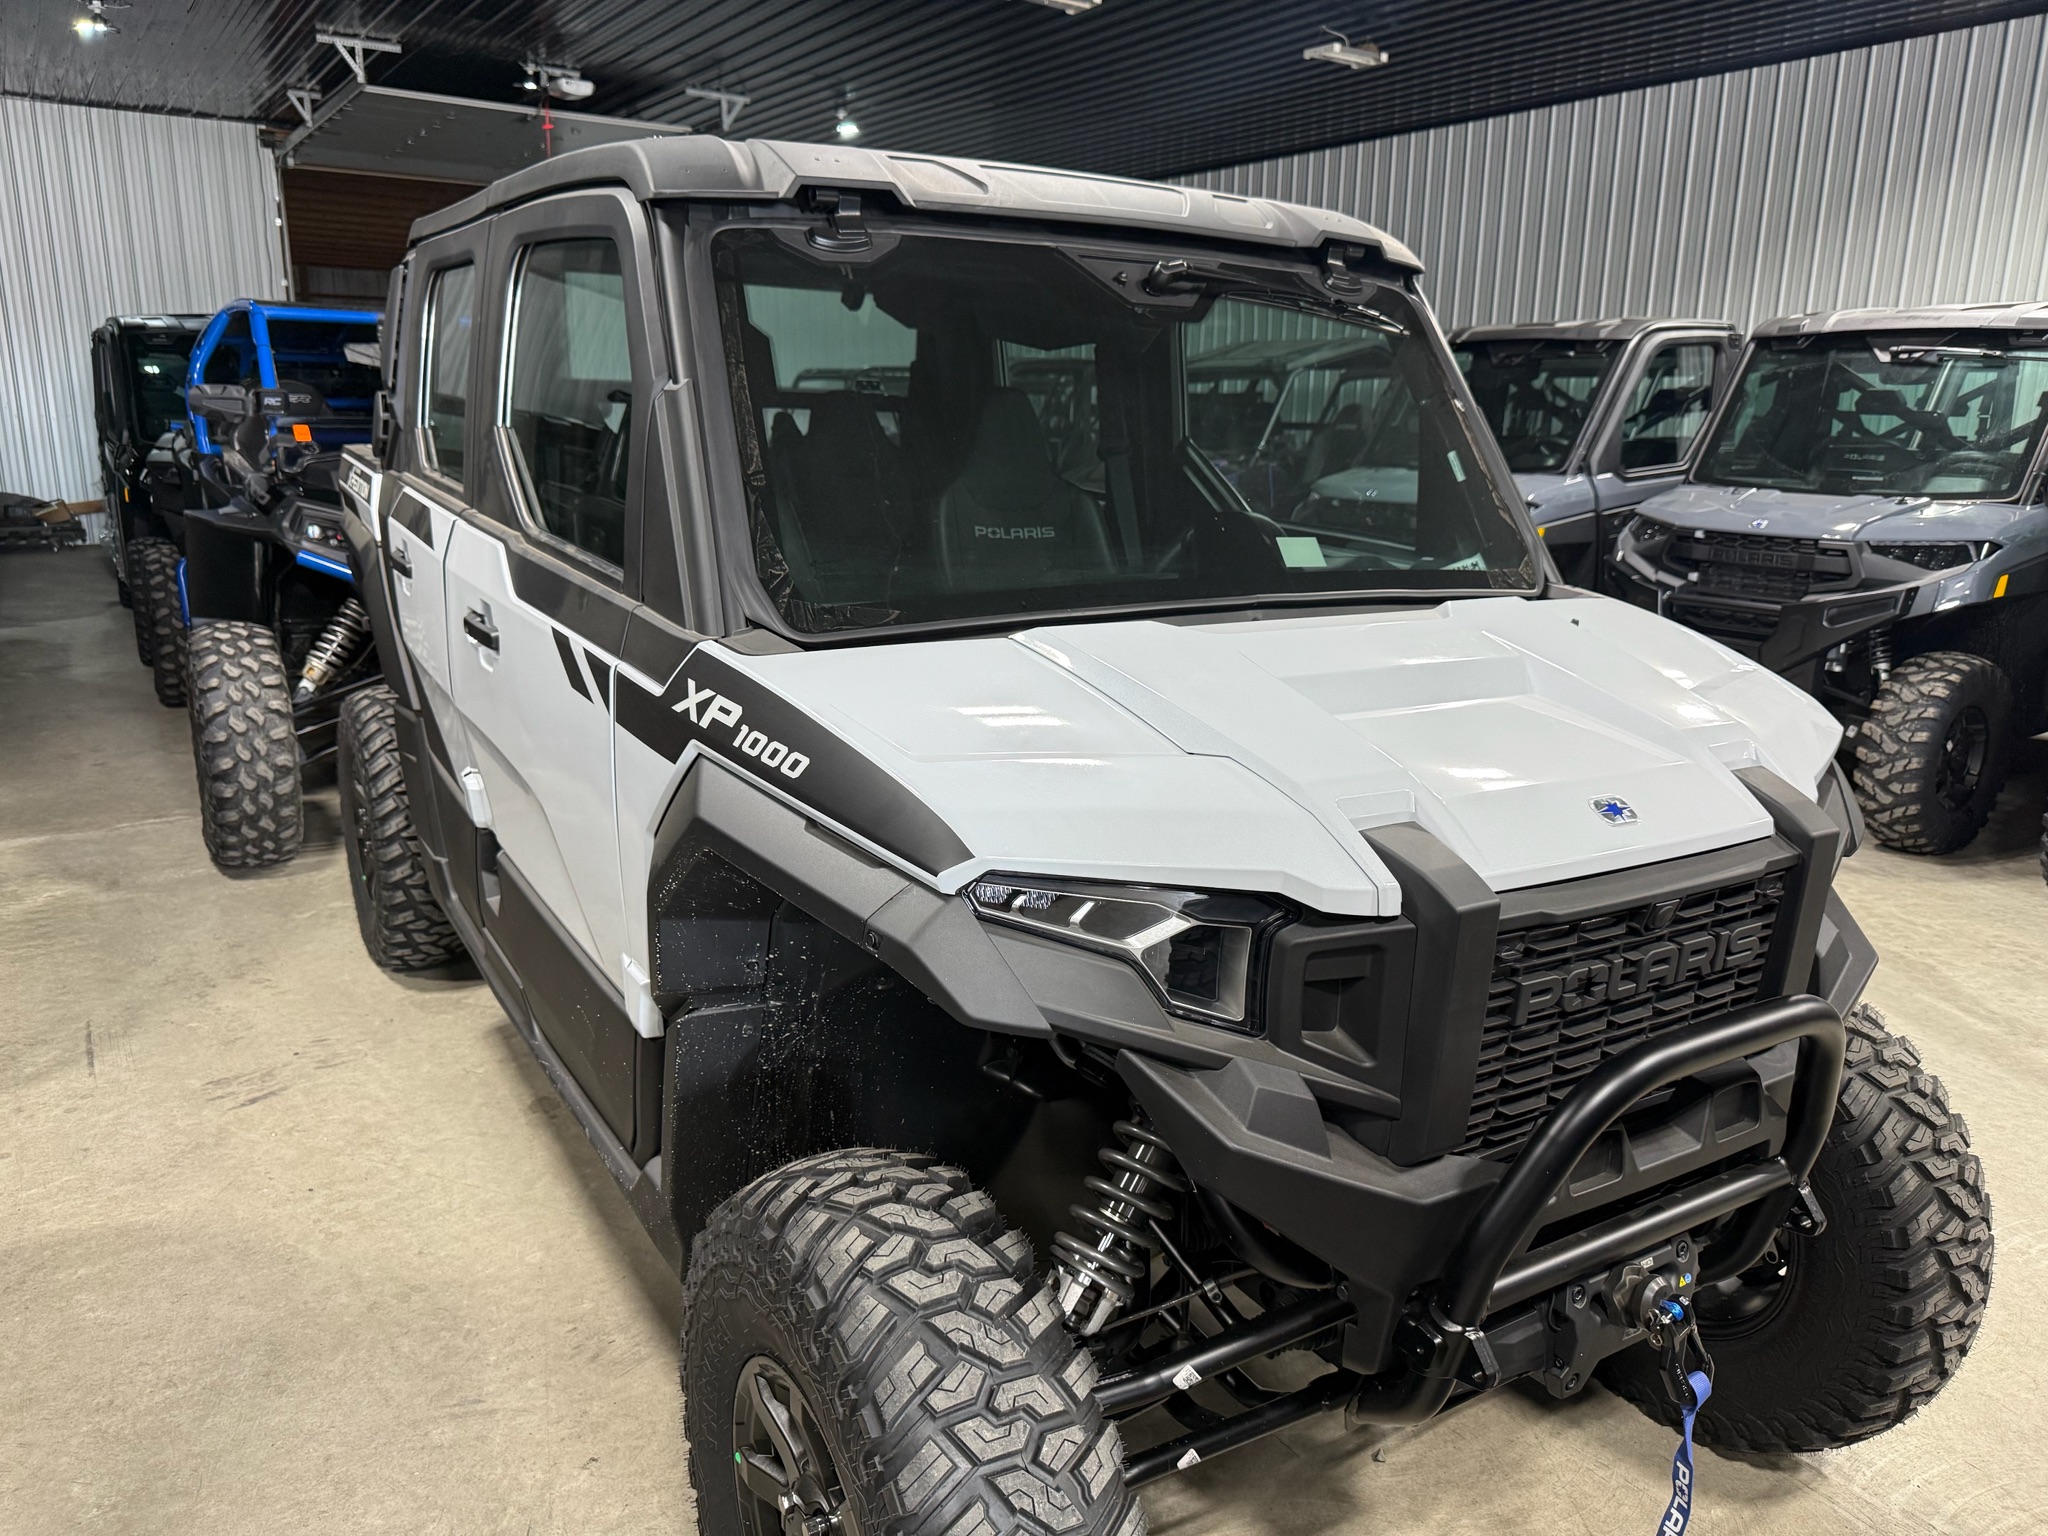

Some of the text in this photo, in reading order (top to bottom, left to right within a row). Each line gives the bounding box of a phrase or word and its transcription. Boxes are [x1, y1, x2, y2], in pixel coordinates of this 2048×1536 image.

[974, 525, 1055, 540] POLARIS
[1710, 547, 1798, 569] POLARIS
[671, 677, 810, 779] XP 1000
[1508, 922, 1762, 1026] POLARIS
